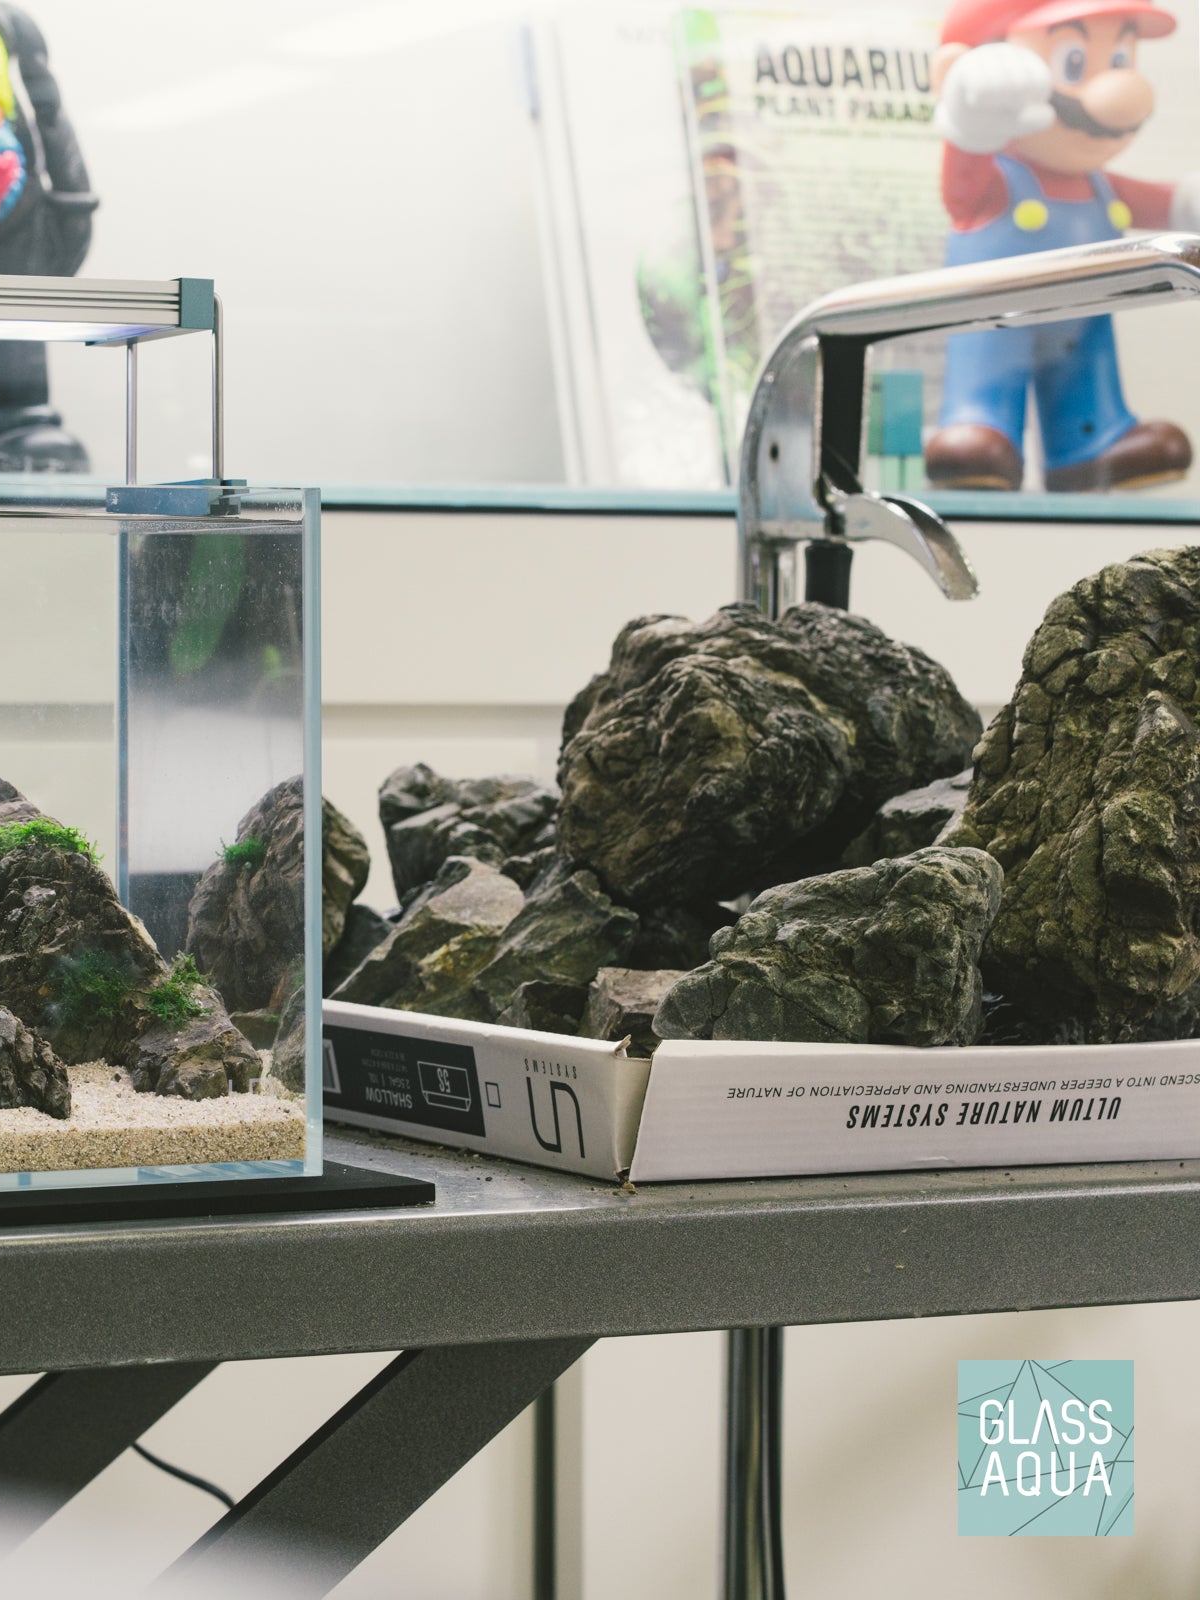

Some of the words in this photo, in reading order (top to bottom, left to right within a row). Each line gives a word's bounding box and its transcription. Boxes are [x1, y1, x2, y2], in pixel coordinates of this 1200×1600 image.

[524, 1058, 577, 1079] SYSTEMS
[436, 1067, 451, 1093] 5S
[1060, 1078, 1112, 1090] DEEPER
[1116, 1078, 1124, 1087] A
[1126, 1076, 1157, 1087] INTO
[726, 1087, 782, 1099] NATURE
[786, 1086, 805, 1097] OF
[809, 1084, 911, 1097] APPRECIATION
[913, 1083, 942, 1095] AND
[945, 1080, 1056, 1094] UNDERSTANDING
[365, 1086, 413, 1109] SHALLOW
[846, 1103, 949, 1129] SYSTEMS
[956, 1100, 1042, 1125] NATURE
[1049, 1097, 1122, 1123] ULTUM
